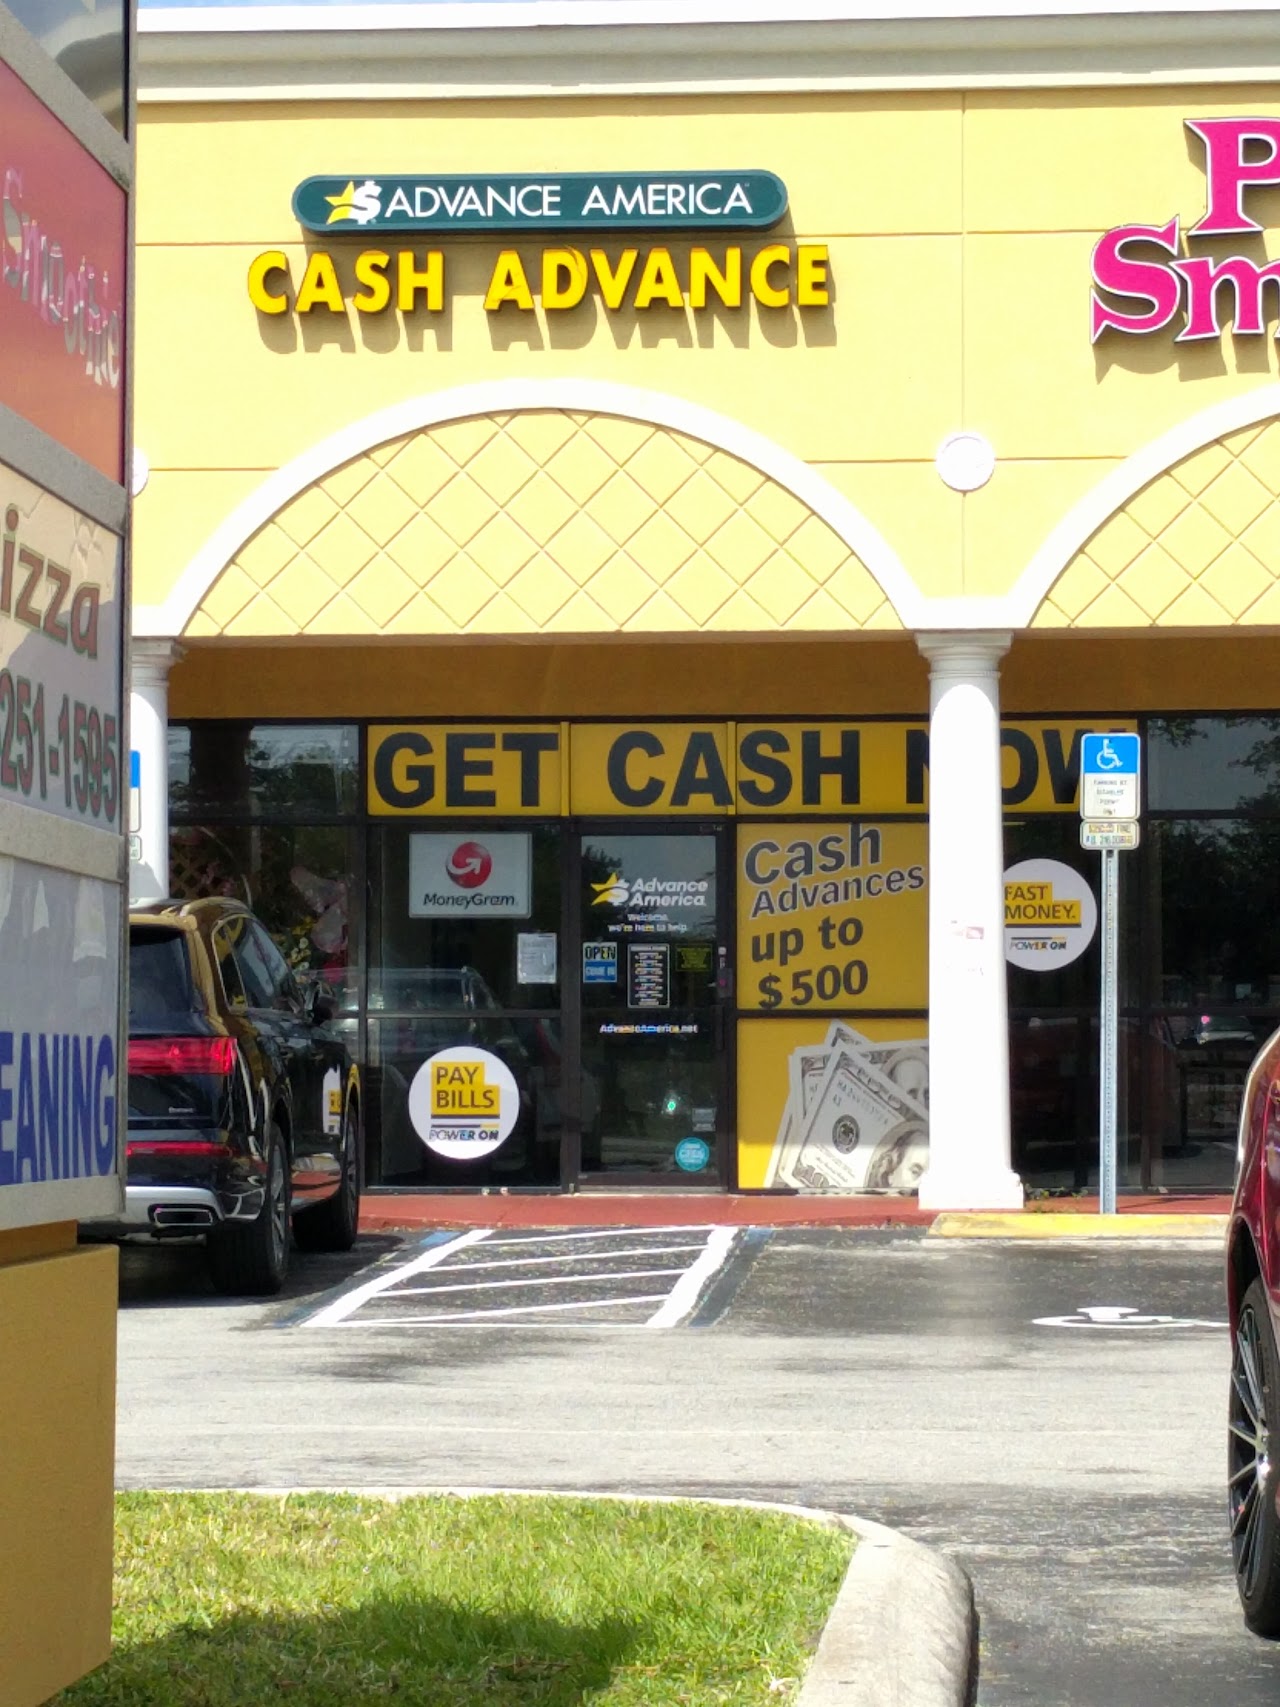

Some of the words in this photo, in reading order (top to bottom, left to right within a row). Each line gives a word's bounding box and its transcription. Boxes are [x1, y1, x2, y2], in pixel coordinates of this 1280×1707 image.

[384, 184, 561, 218] ADVANCE
[581, 182, 753, 216] AMERICA
[247, 249, 445, 314] CASH
[482, 244, 829, 311] ADVANCE
[373, 732, 559, 808] GET
[607, 729, 861, 807] CASH
[745, 823, 881, 885] Cash
[630, 877, 709, 893] Advance
[751, 866, 925, 919] Advances
[1004, 886, 1049, 901] FAST
[423, 893, 515, 910] MoneyGram
[629, 892, 706, 907] America
[751, 927, 804, 966] up
[818, 916, 864, 950] to
[585, 946, 616, 960] OPEN
[758, 959, 868, 1010] $500
[436, 1066, 479, 1085] PAY
[436, 1090, 495, 1109] BILLS
[478, 1130, 500, 1141] ON
